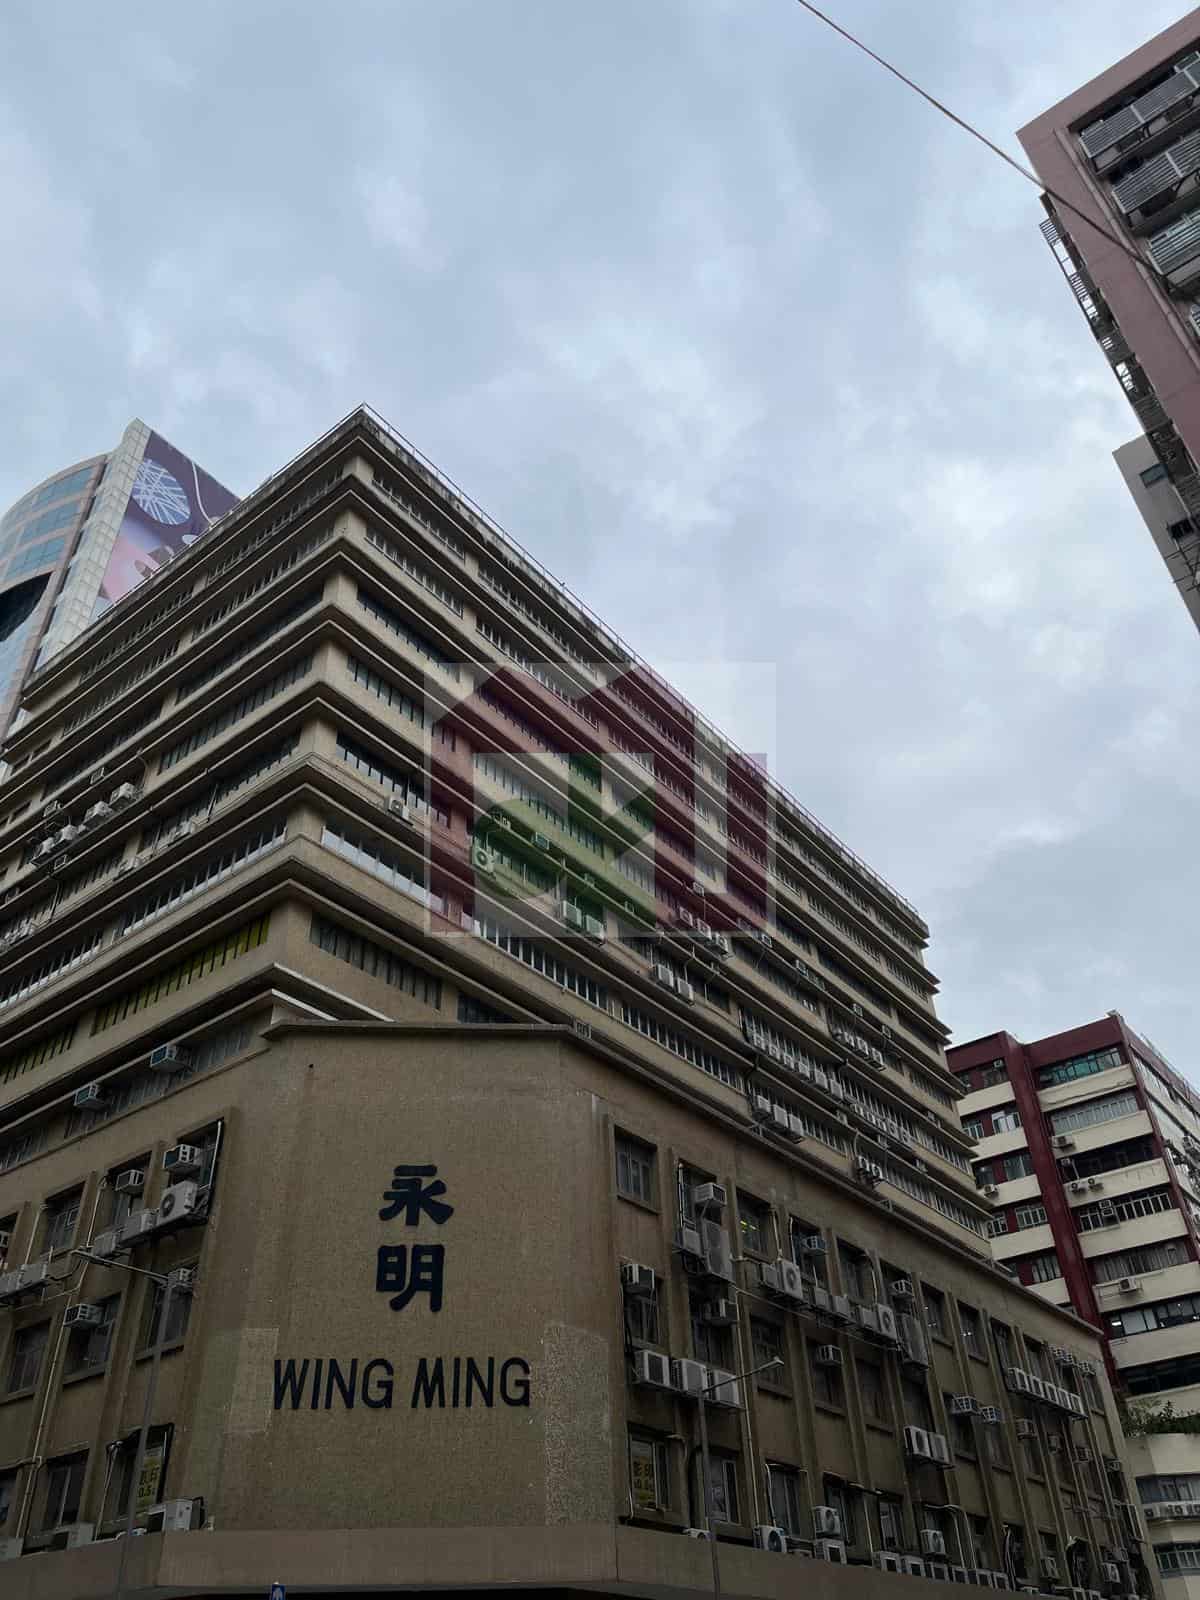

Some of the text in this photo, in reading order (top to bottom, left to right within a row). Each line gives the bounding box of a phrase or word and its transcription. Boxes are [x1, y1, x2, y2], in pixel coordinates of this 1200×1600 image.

[376, 1164, 454, 1313] 永明
[273, 1356, 531, 1410] WING MING
